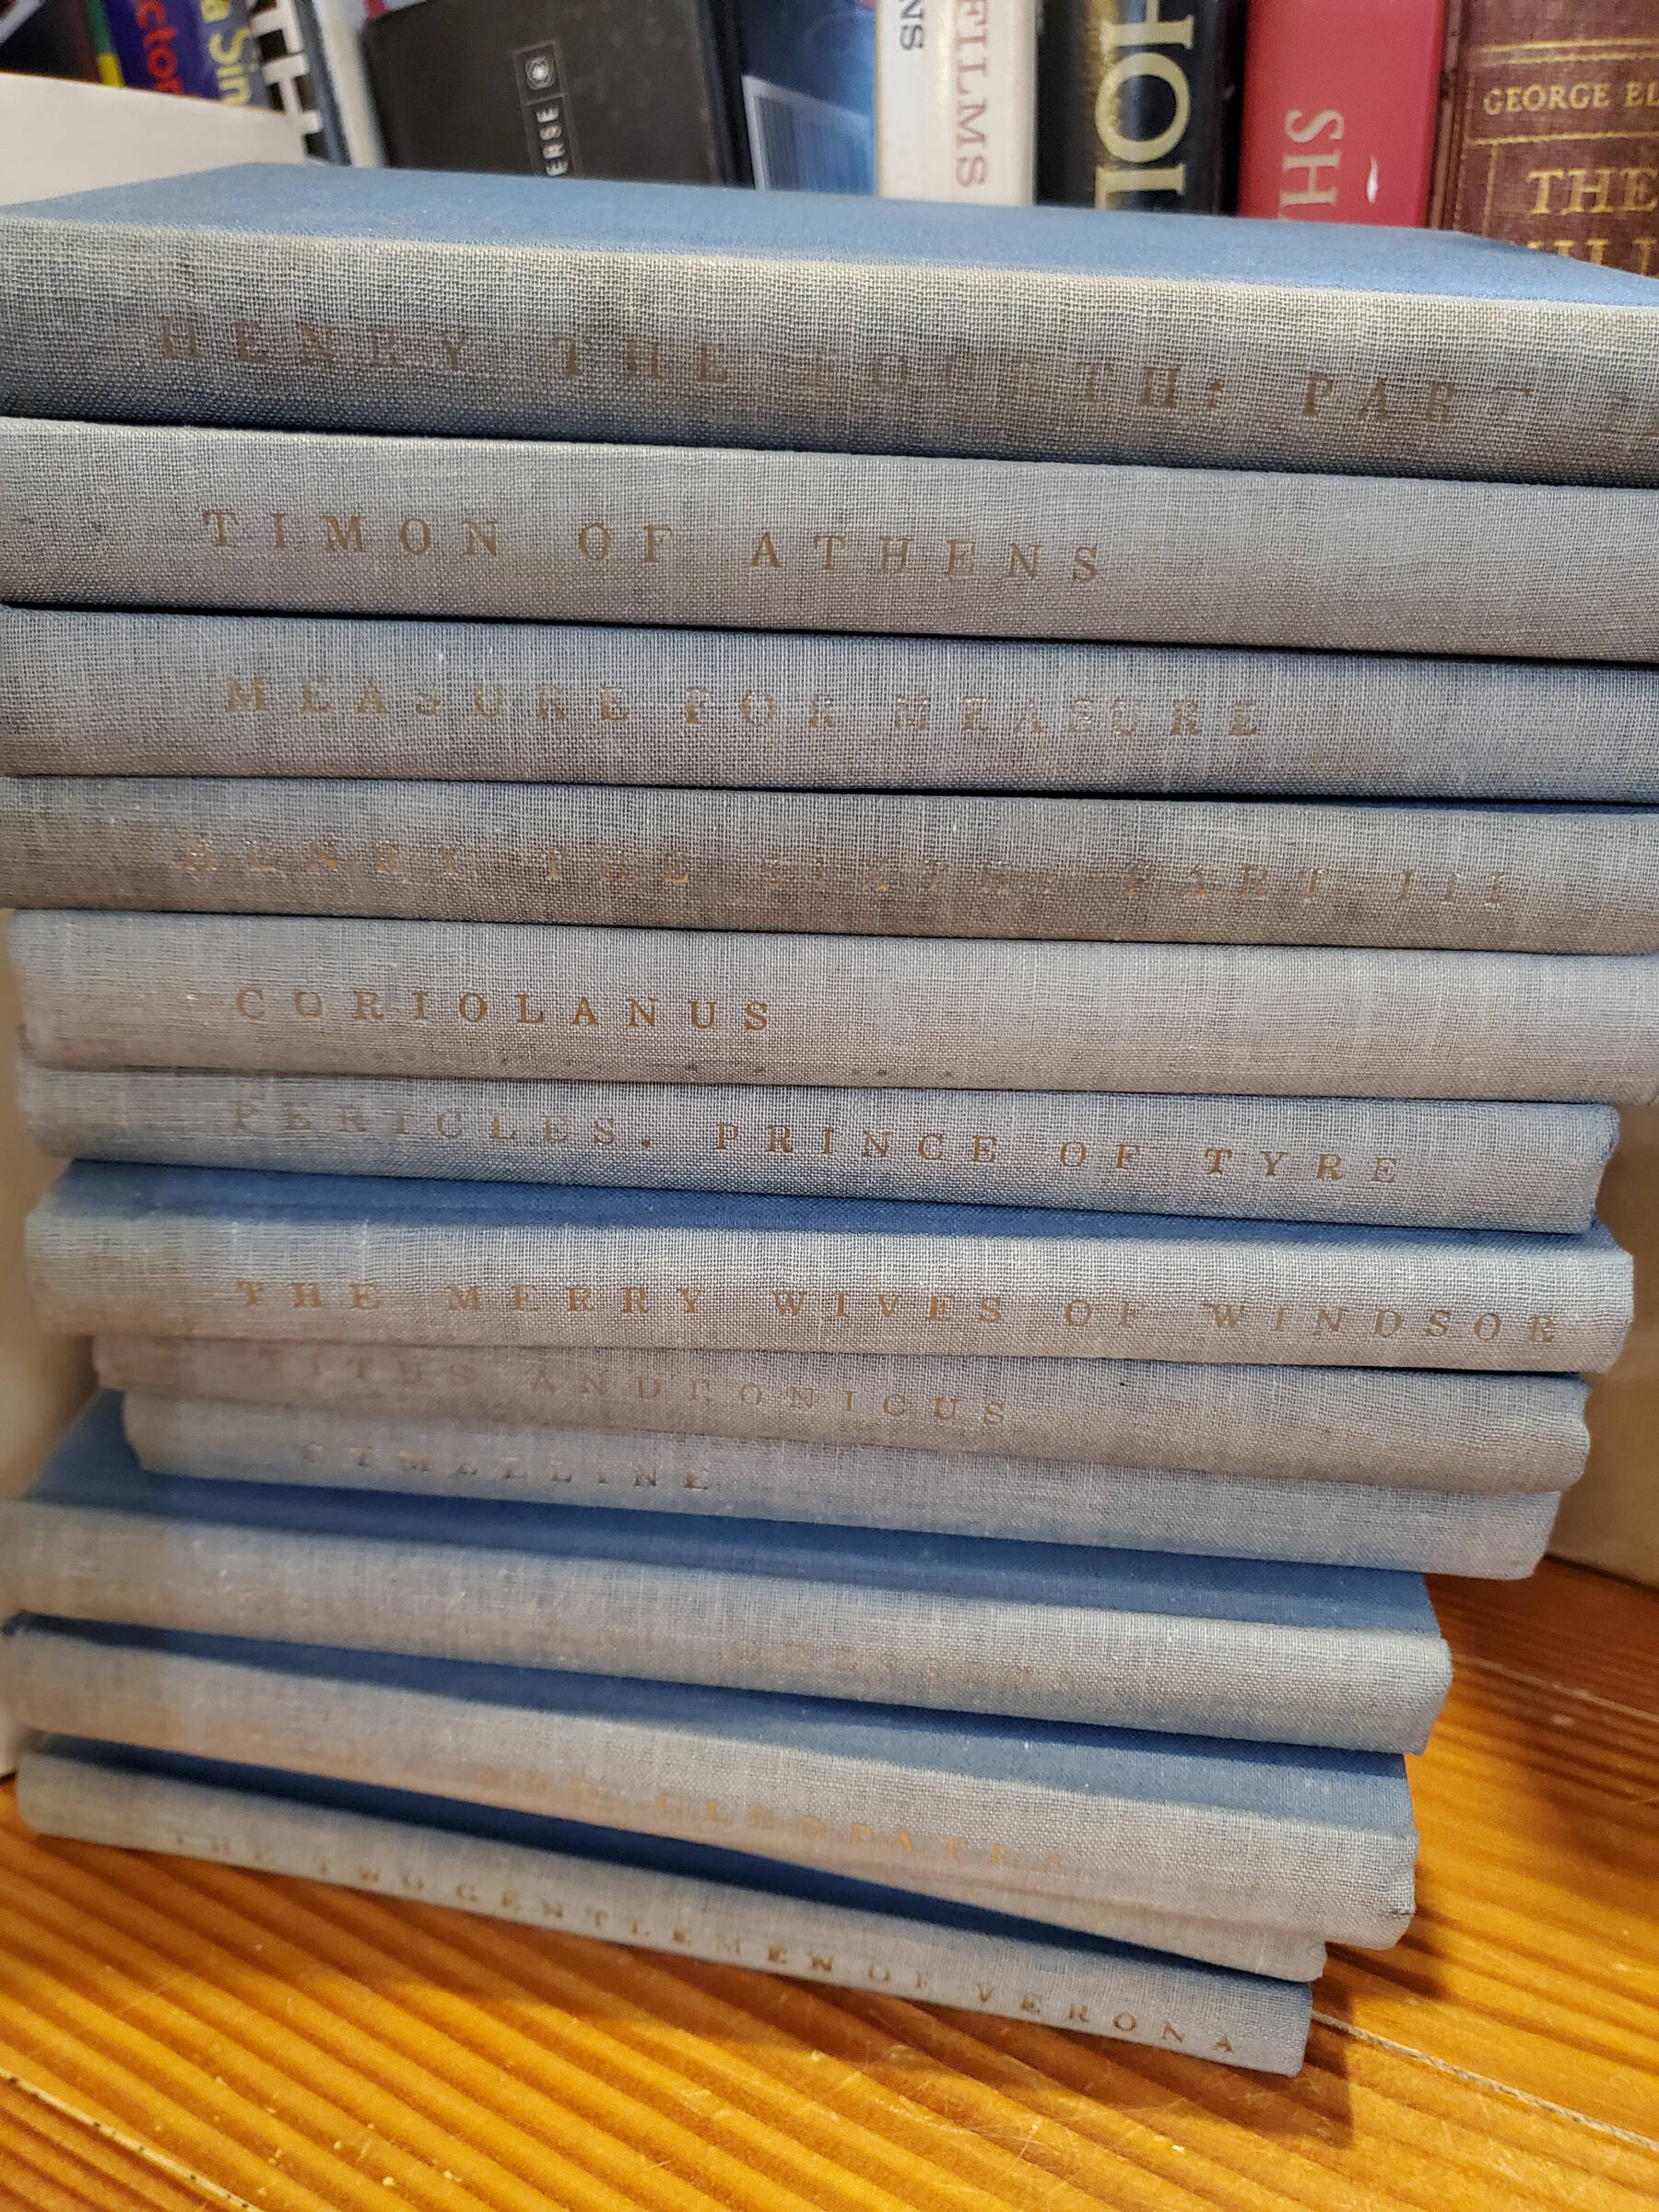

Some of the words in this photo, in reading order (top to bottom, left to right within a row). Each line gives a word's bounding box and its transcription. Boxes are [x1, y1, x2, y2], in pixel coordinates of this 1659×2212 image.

[955, 0, 990, 188] FILMS
[1483, 82, 1611, 116] GEORGE
[1279, 109, 1345, 219] SH
[1526, 167, 1659, 216] THE
[202, 508, 499, 556] TIMON
[577, 522, 673, 564] OF
[750, 531, 1099, 582] ATHENS
[225, 676, 629, 722] MEASURE
[685, 686, 836, 729] FOR
[894, 693, 1259, 736] MEASURE
[236, 988, 770, 1032] CORIOLANUS
[716, 1123, 998, 1165] PRINCE
[1059, 1140, 1141, 1170] OF
[1204, 1147, 1398, 1184] TYRE
[237, 1280, 382, 1310] THE
[446, 1283, 706, 1314] MERRY
[771, 1289, 1004, 1324] WIVES
[1065, 1299, 1144, 1329] OF
[1206, 1302, 1556, 1344] WINDSOR
[528, 1364, 1005, 1426] ANDRONICUS
[976, 1982, 1238, 2053] VERONA
